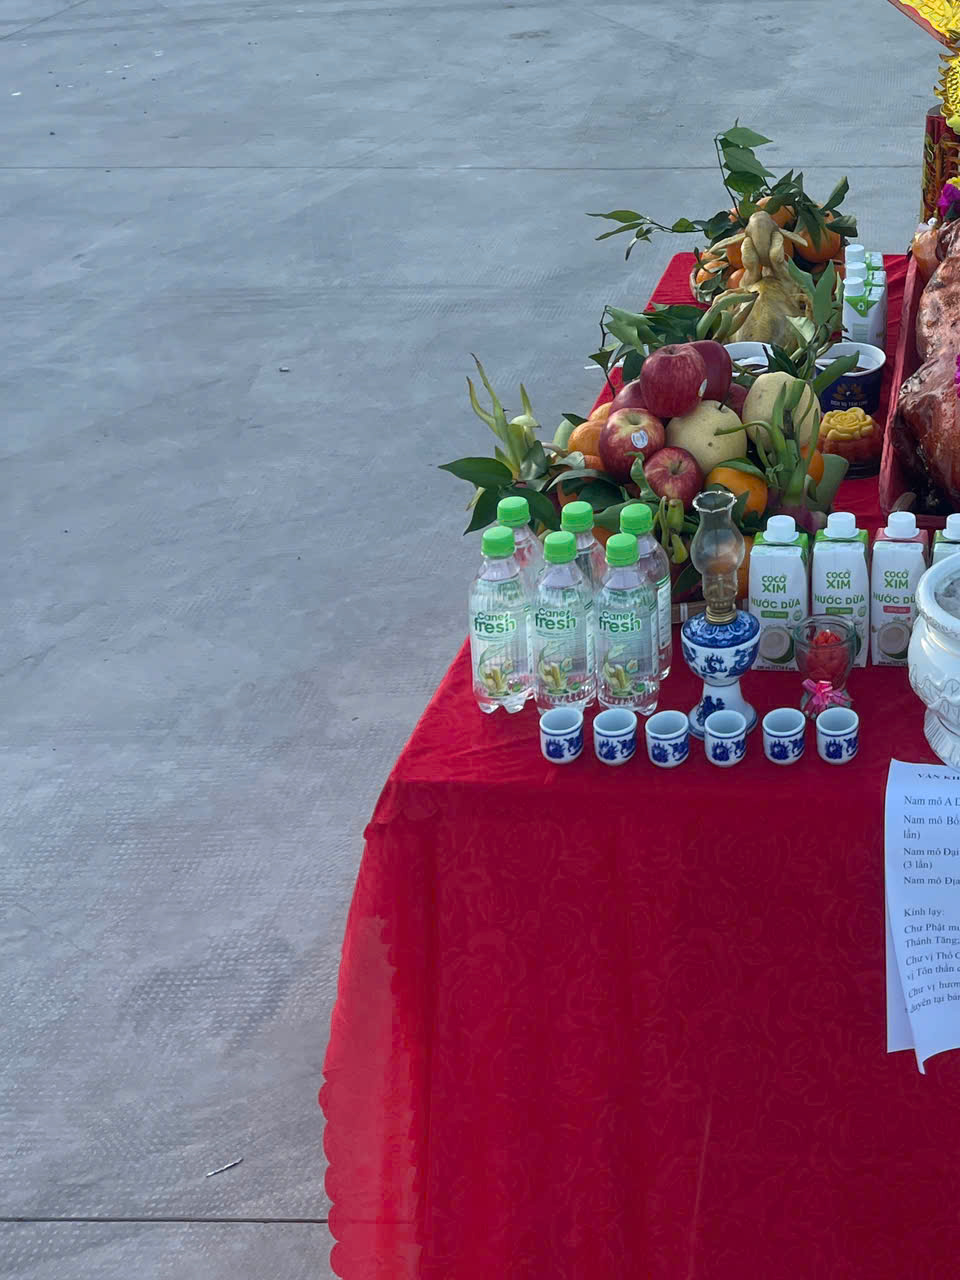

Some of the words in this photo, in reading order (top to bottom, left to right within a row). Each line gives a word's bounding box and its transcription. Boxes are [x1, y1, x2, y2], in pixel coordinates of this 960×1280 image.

[762, 583, 787, 594] XIM
[826, 580, 851, 590] XIM
[884, 579, 909, 589] XIM
[903, 593, 916, 604] DỪ
[474, 614, 516, 634] fresh
[535, 611, 576, 630] fresh
[599, 614, 641, 633] fresh
[904, 795, 925, 805] Nam
[944, 797, 952, 806] A
[903, 814, 925, 825] Nam
[903, 847, 925, 856] Nam
[903, 860, 913, 870] (3
[903, 876, 925, 885] Nam
